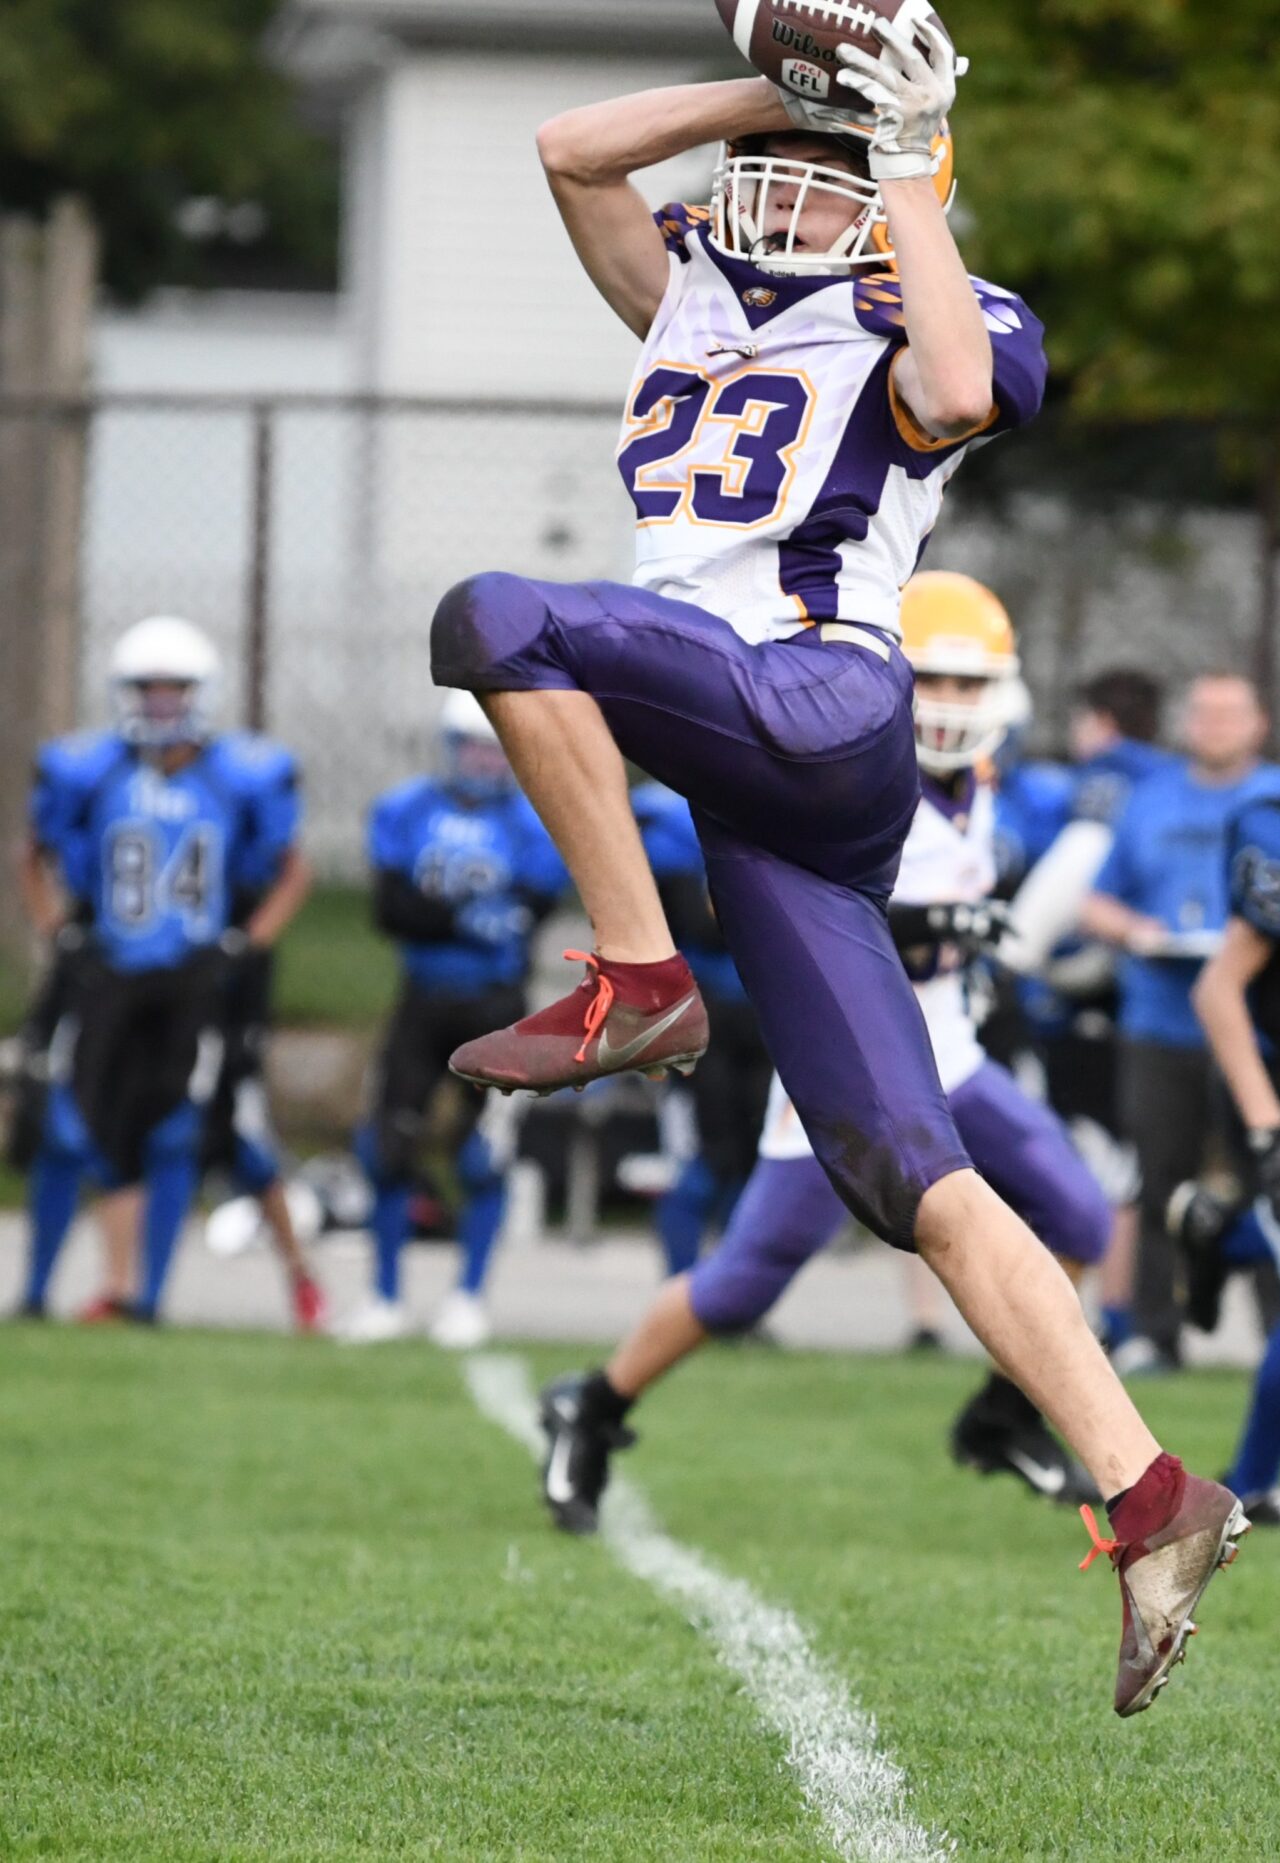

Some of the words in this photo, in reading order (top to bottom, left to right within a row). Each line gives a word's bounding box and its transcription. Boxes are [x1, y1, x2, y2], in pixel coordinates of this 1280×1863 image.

[772, 17, 842, 65] Wilso
[789, 69, 821, 93] CFL
[615, 360, 818, 531] 23
[102, 815, 226, 943] 84
